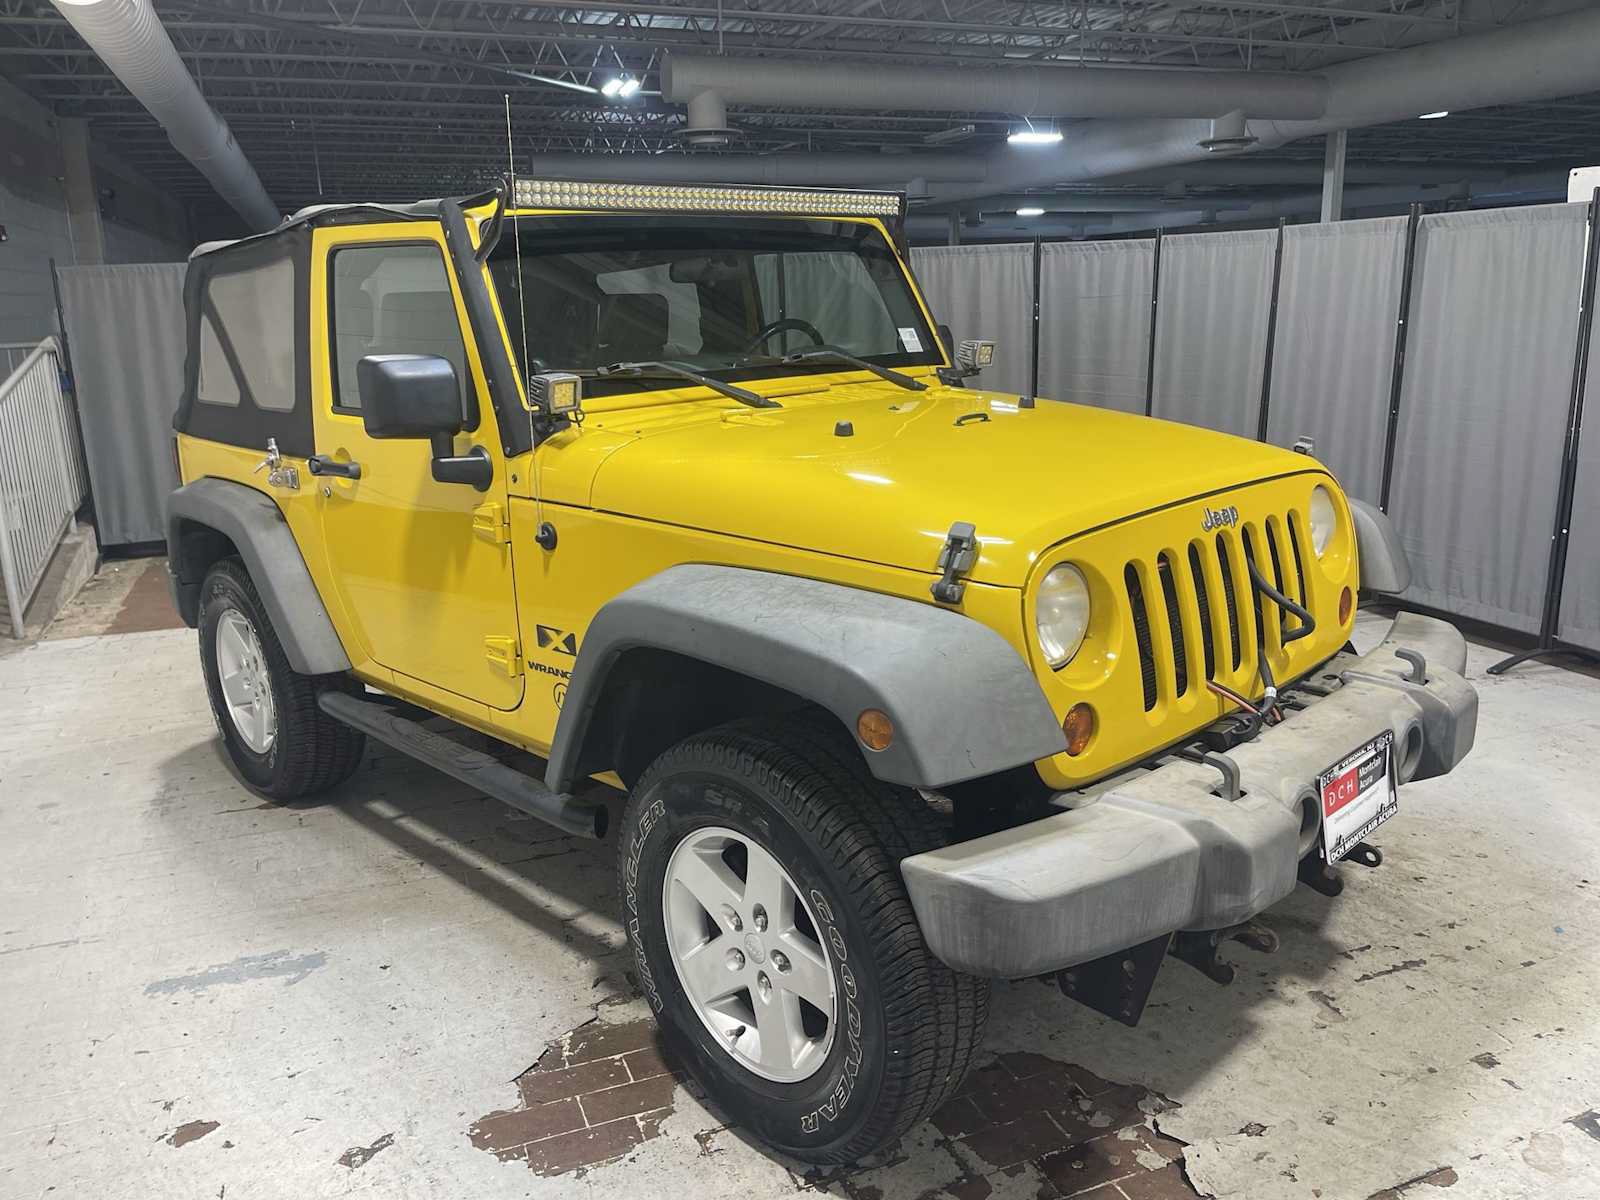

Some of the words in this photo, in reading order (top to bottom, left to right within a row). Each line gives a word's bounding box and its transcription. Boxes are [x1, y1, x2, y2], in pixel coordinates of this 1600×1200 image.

[1201, 506, 1238, 532] Jeep
[1359, 755, 1382, 778] Montclair
[1328, 781, 1353, 807] DCH
[1359, 775, 1373, 791] Acura
[1330, 844, 1344, 862] DCH
[1344, 819, 1378, 851] MONTCLAIR
[1377, 805, 1397, 825] ACURA
[625, 799, 667, 1014] WRANGLER
[800, 888, 864, 1134] GOODYEAR
